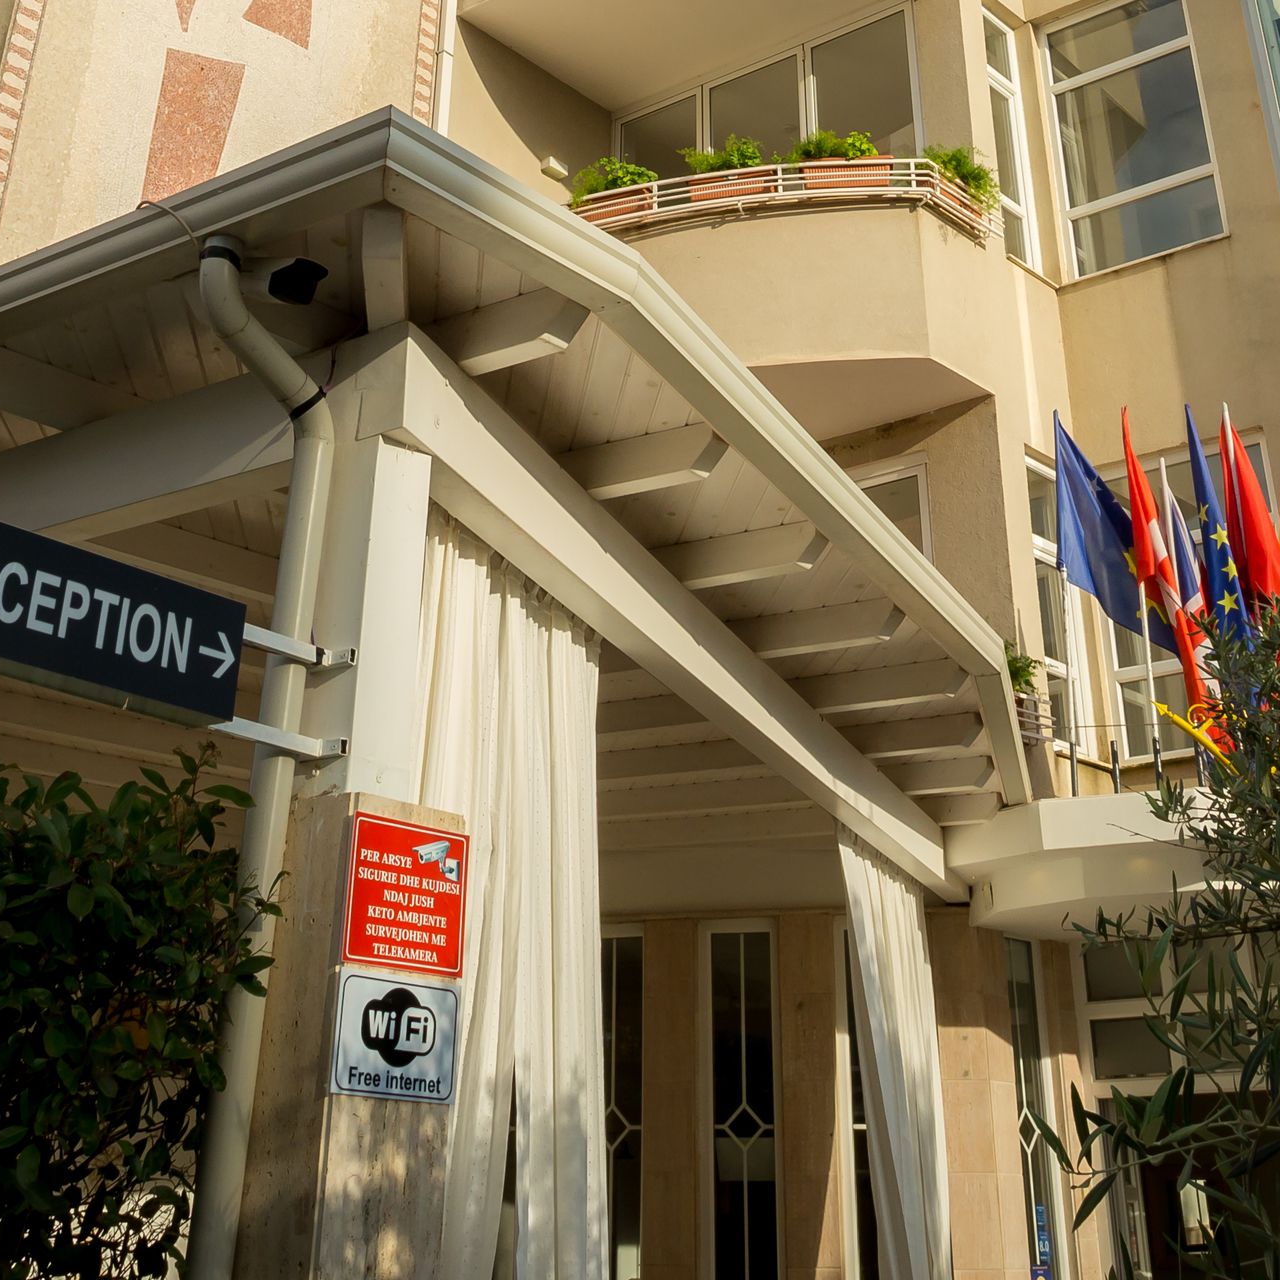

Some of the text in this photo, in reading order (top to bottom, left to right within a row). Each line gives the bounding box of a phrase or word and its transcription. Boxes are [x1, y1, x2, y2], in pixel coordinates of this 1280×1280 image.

[360, 848, 412, 869] PER ARSYE
[358, 866, 460, 895] SIGURIE DHE KUJDESI
[383, 889, 434, 909] NDAJ JUSH
[367, 905, 447, 929] KETO AMBJENTE
[365, 923, 446, 946] SURVEJOHEN ME
[372, 942, 438, 963] TELEKAMERA
[348, 1066, 442, 1094] Free internet
